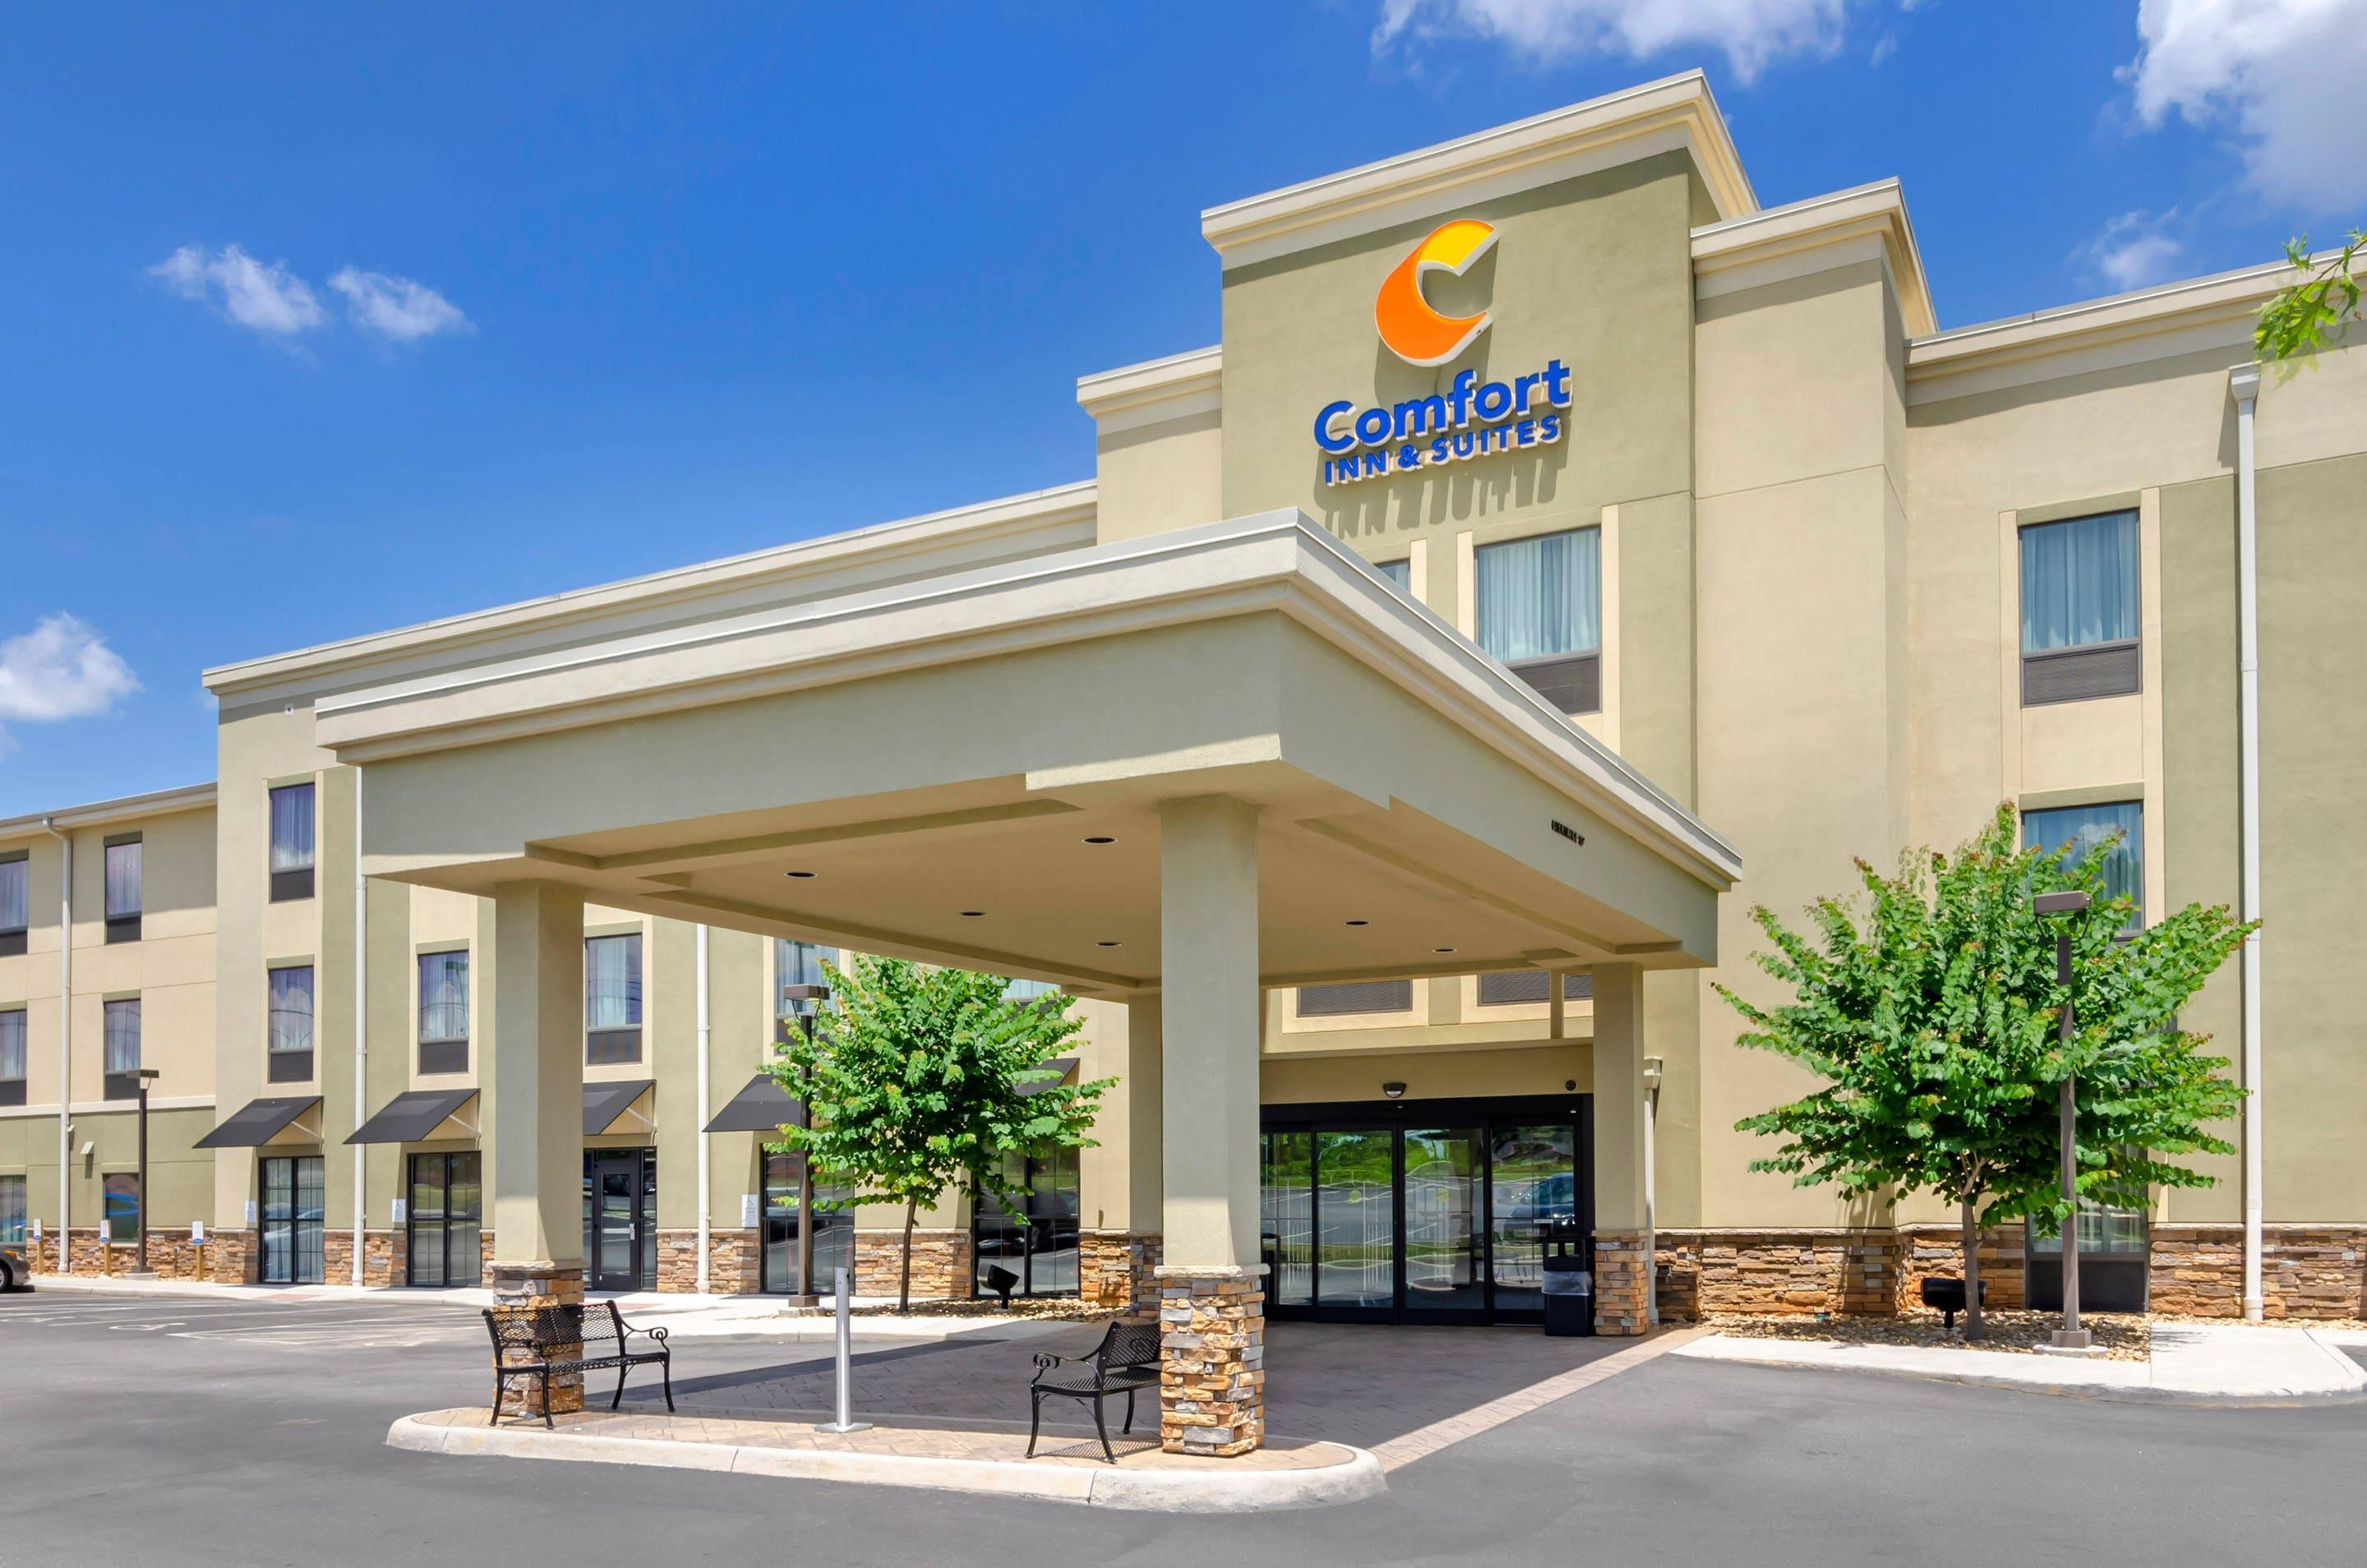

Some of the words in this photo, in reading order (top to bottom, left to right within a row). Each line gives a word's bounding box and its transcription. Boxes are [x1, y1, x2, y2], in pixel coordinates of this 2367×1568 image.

[1313, 359, 1571, 454] Comfort
[1325, 450, 1389, 486] INN
[1398, 444, 1423, 471] &
[1430, 414, 1561, 464] SUITES
